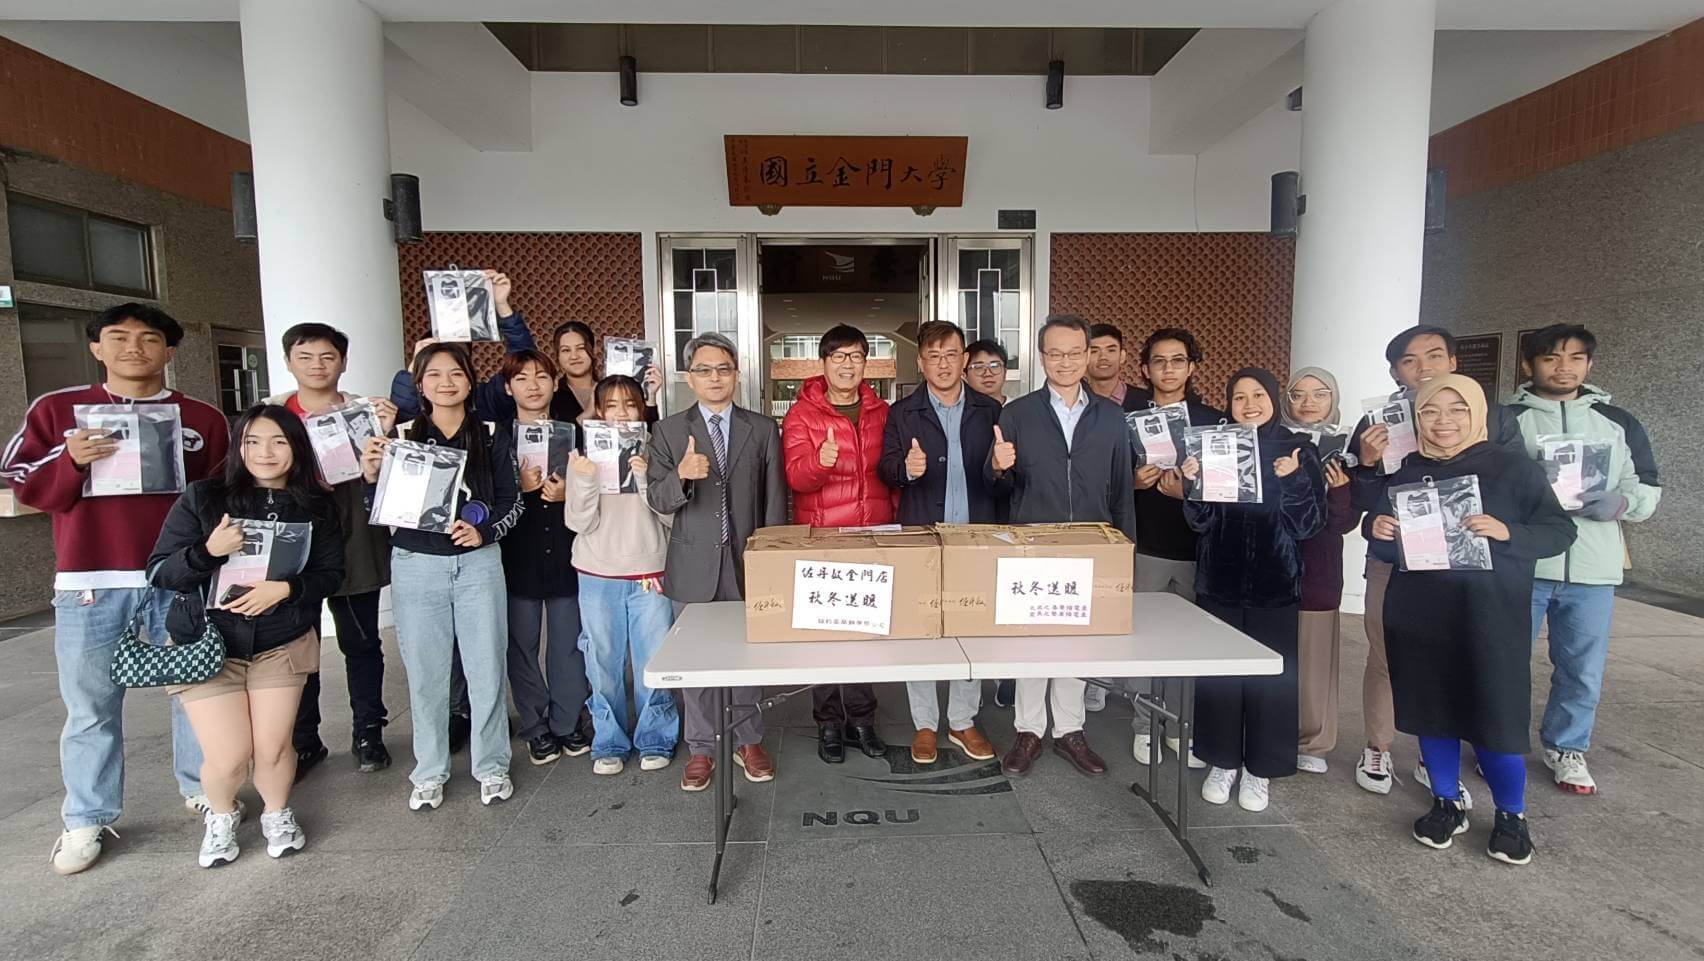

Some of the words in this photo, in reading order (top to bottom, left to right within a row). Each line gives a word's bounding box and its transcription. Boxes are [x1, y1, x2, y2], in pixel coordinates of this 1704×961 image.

[759, 154, 957, 191] 國立金門大學
[801, 566, 888, 583] 佐丹奴金門店
[1011, 580, 1080, 596] 秋冬送暖
[808, 590, 878, 609] 秋冬送暖
[803, 809, 920, 827] NQU
